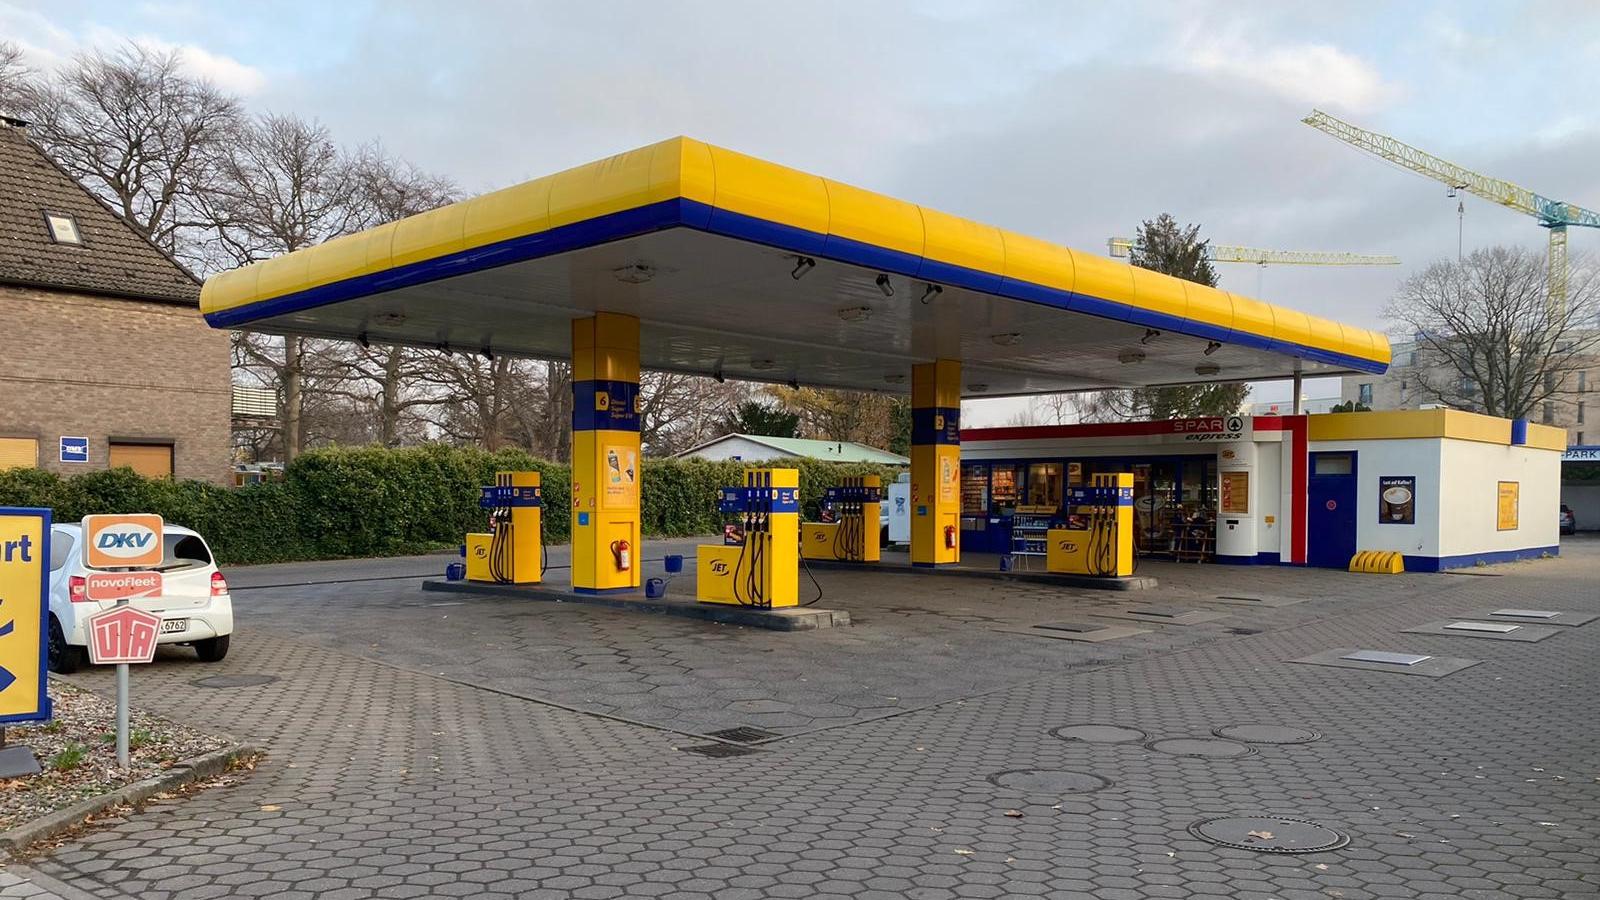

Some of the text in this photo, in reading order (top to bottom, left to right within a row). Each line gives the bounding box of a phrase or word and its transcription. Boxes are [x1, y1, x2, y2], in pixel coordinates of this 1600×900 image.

[1174, 420, 1223, 431] SPAR
[1185, 432, 1242, 441] express
[98, 533, 153, 548] DKV
[0, 535, 31, 562] rt
[95, 608, 157, 658] UTA
